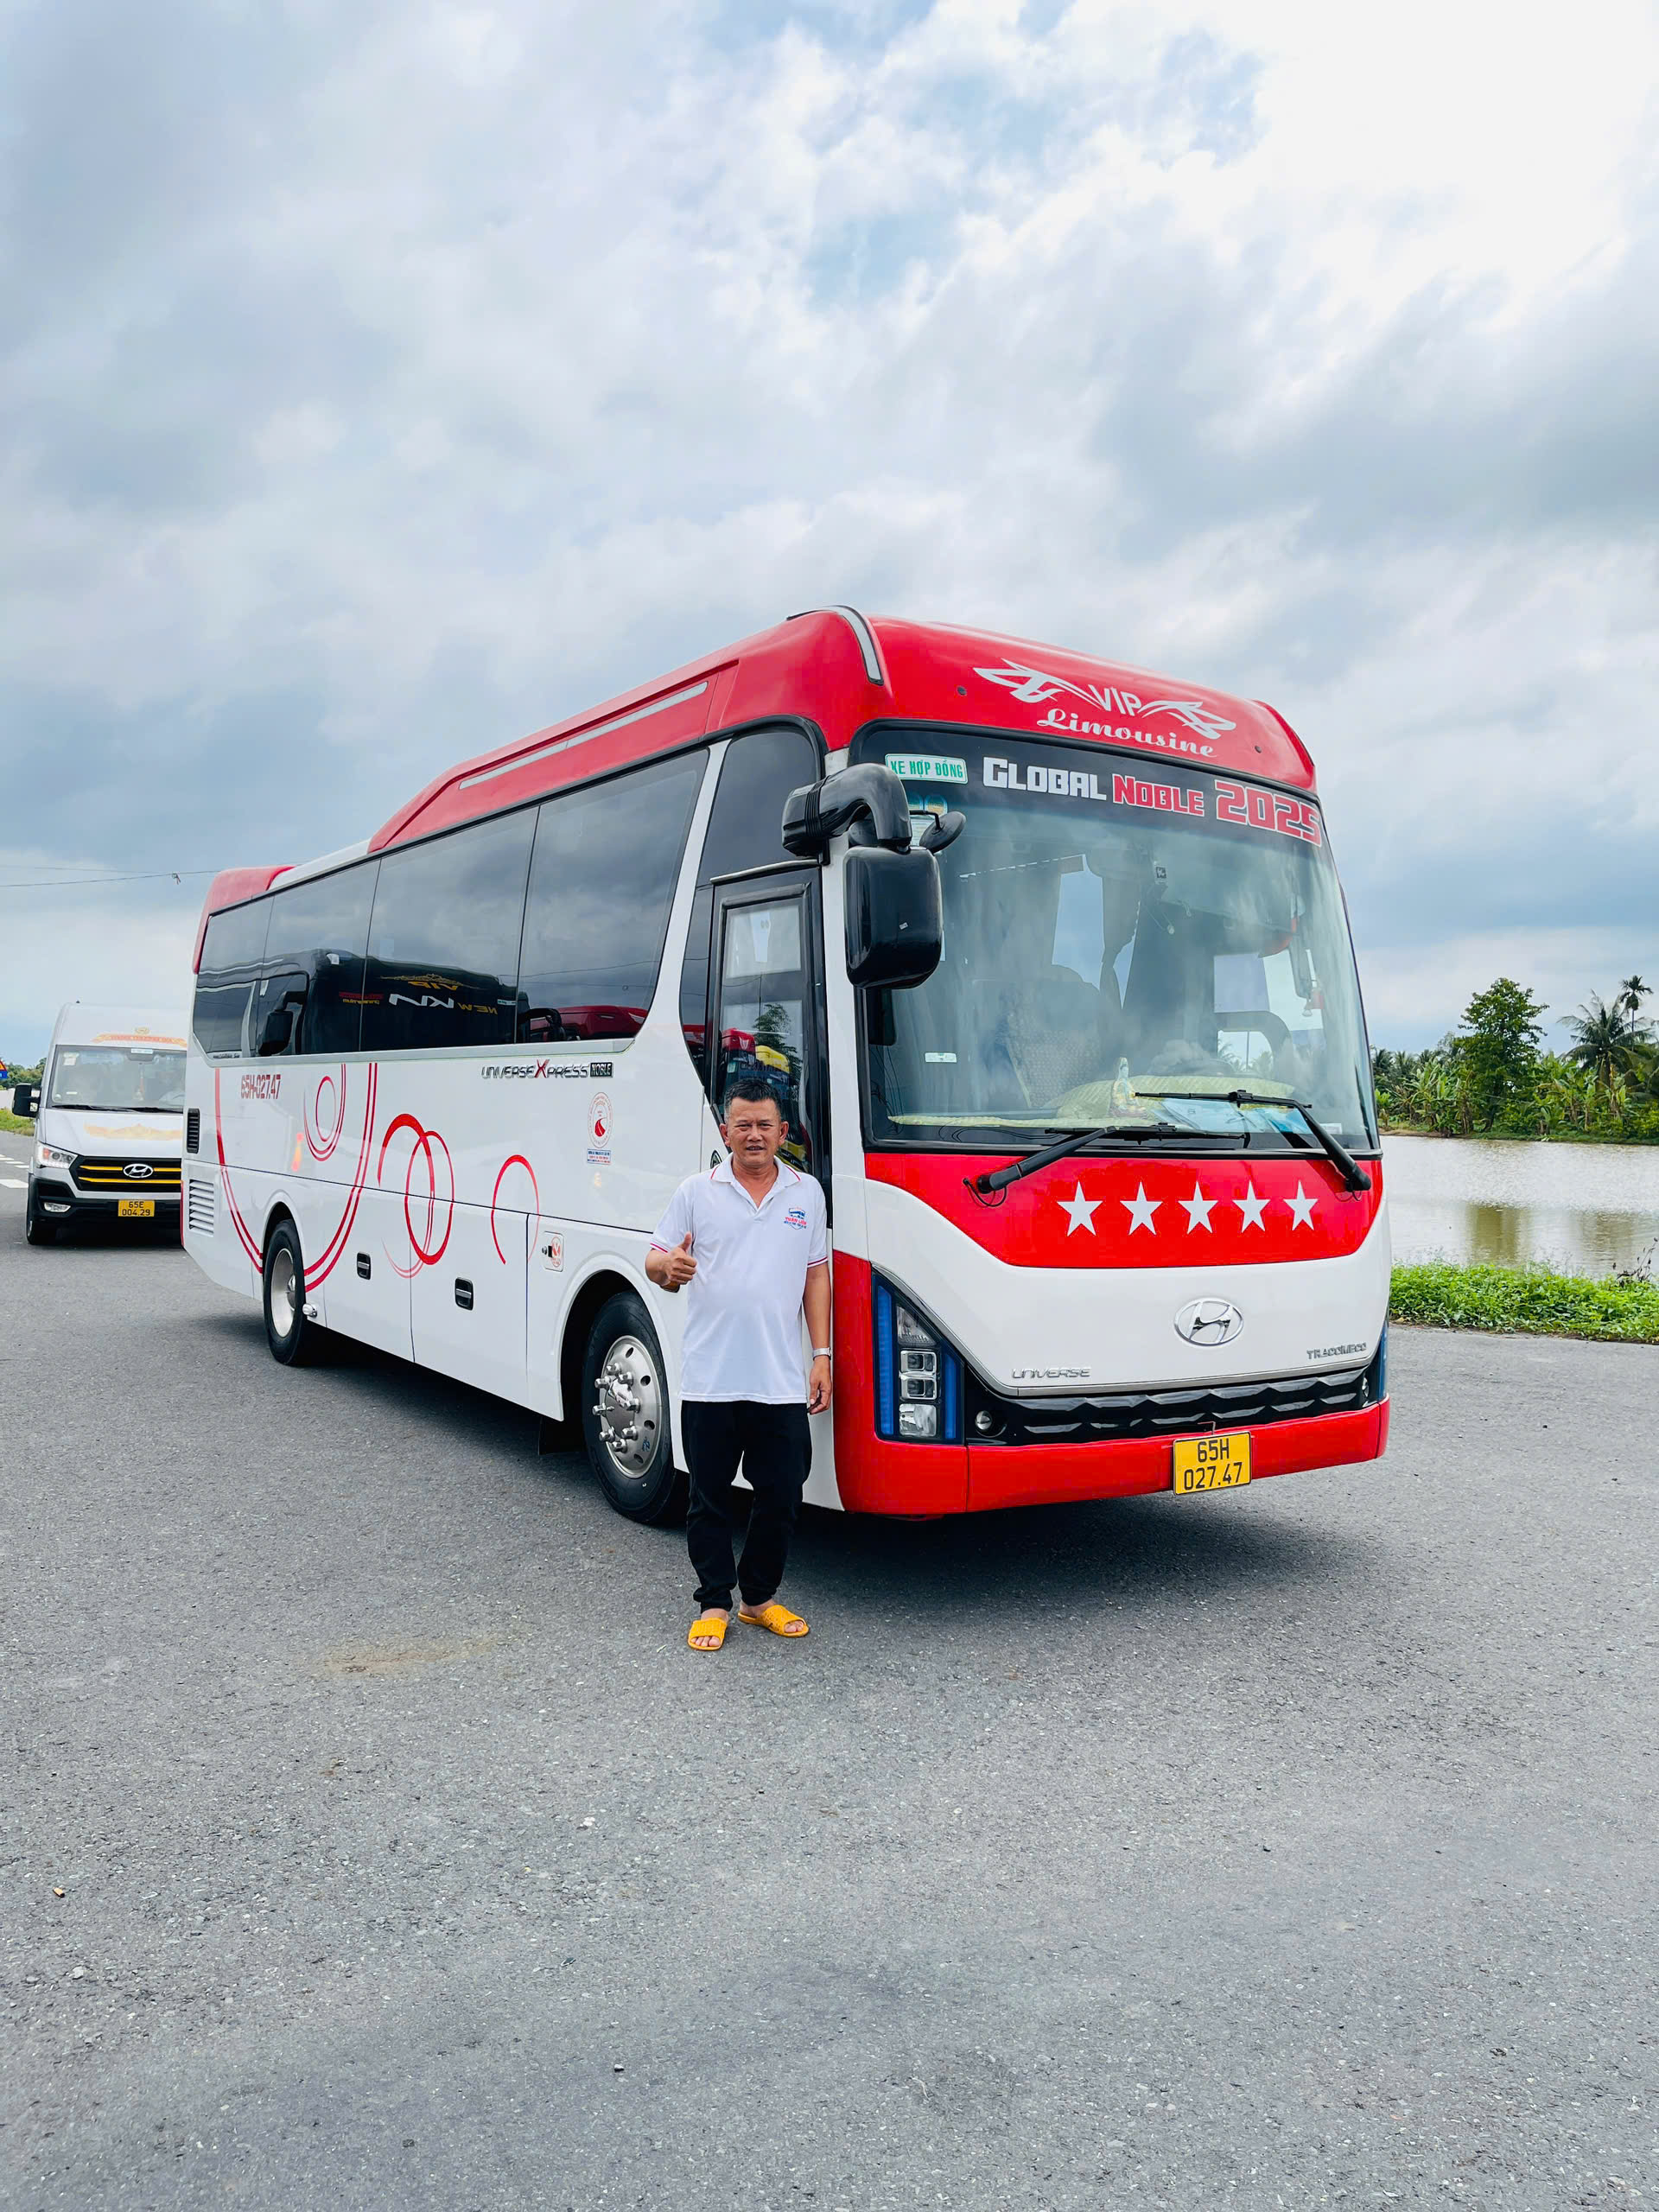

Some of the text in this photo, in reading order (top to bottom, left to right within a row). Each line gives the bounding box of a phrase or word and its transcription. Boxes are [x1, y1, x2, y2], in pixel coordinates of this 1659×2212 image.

[1088, 683, 1141, 716] VIP
[1037, 709, 1217, 757] Limousine
[891, 760, 905, 774] XE
[983, 757, 1322, 848] GLOBAL NOBLE 2025
[1012, 1368, 1091, 1379] UNIVERSE
[1198, 1438, 1230, 1462] 65H
[1184, 1461, 1243, 1491] 027.47
